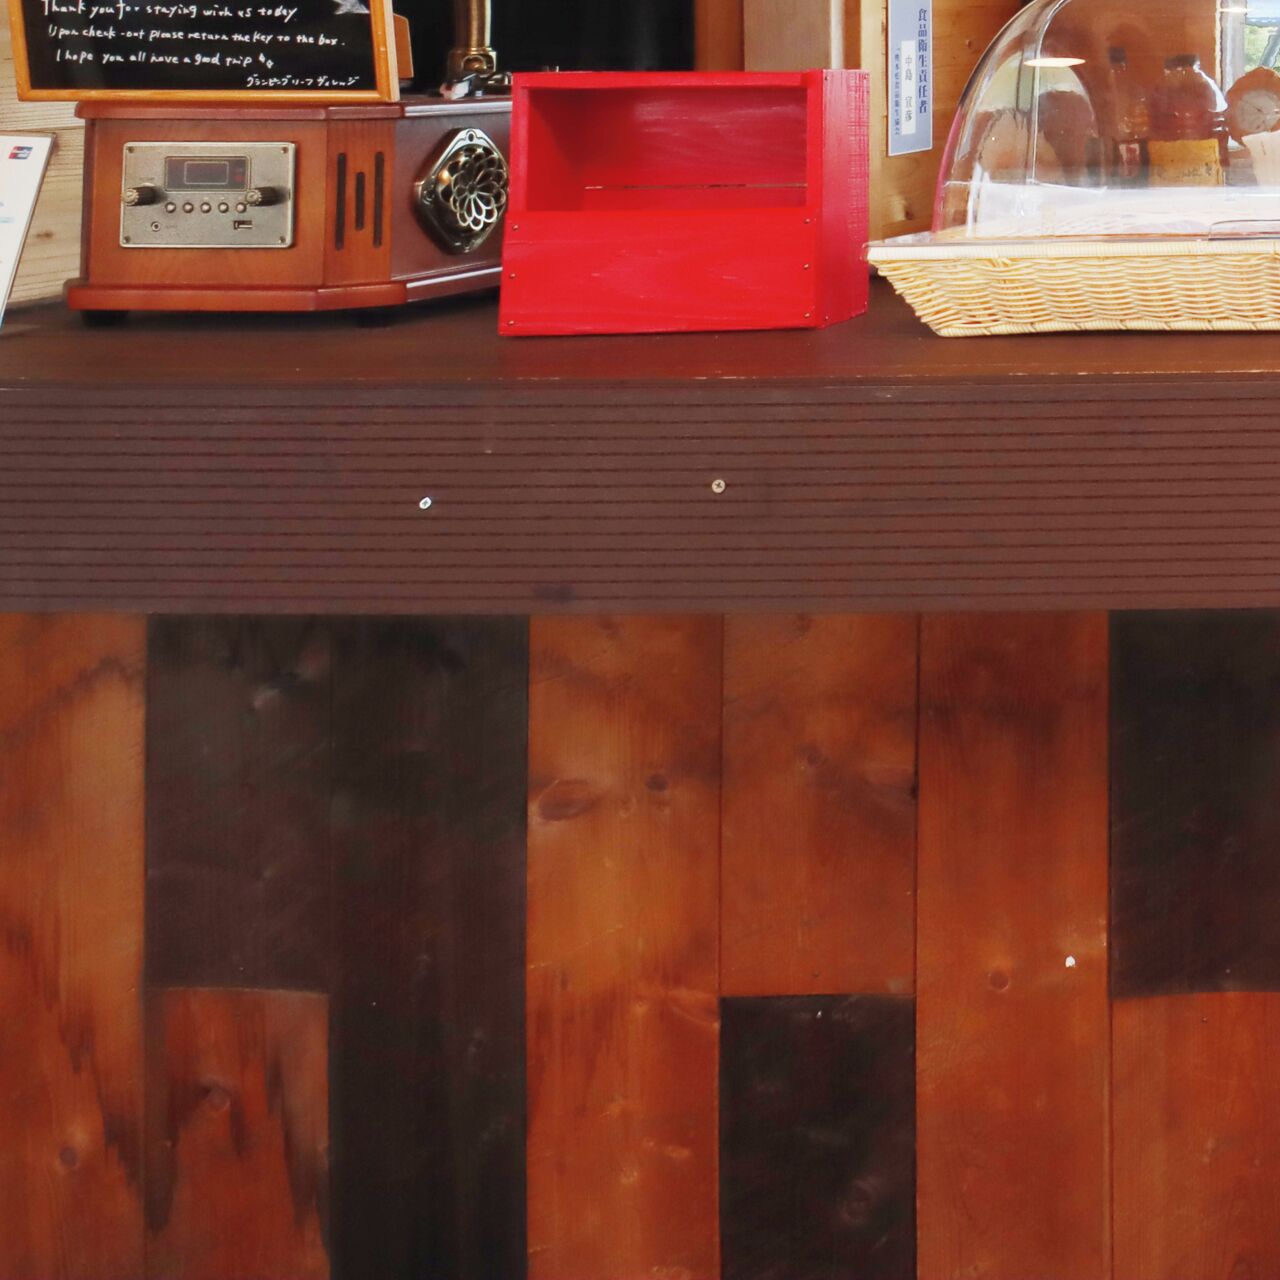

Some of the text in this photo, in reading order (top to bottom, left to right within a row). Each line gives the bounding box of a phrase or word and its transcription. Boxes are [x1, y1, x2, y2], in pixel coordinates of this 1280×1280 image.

[89, 5, 115, 19] you
[146, 4, 197, 18] staying
[203, 4, 233, 17] with
[237, 7, 252, 18] us
[188, 32, 229, 41] return
[231, 33, 250, 42] the
[296, 33, 315, 44] the
[64, 49, 94, 64] hope
[102, 52, 125, 65] you
[129, 50, 147, 63] all
[150, 53, 180, 64] have
[194, 52, 220, 66] good
[225, 55, 253, 68] trip
[918, 8, 928, 114] 食品衛生責任者
